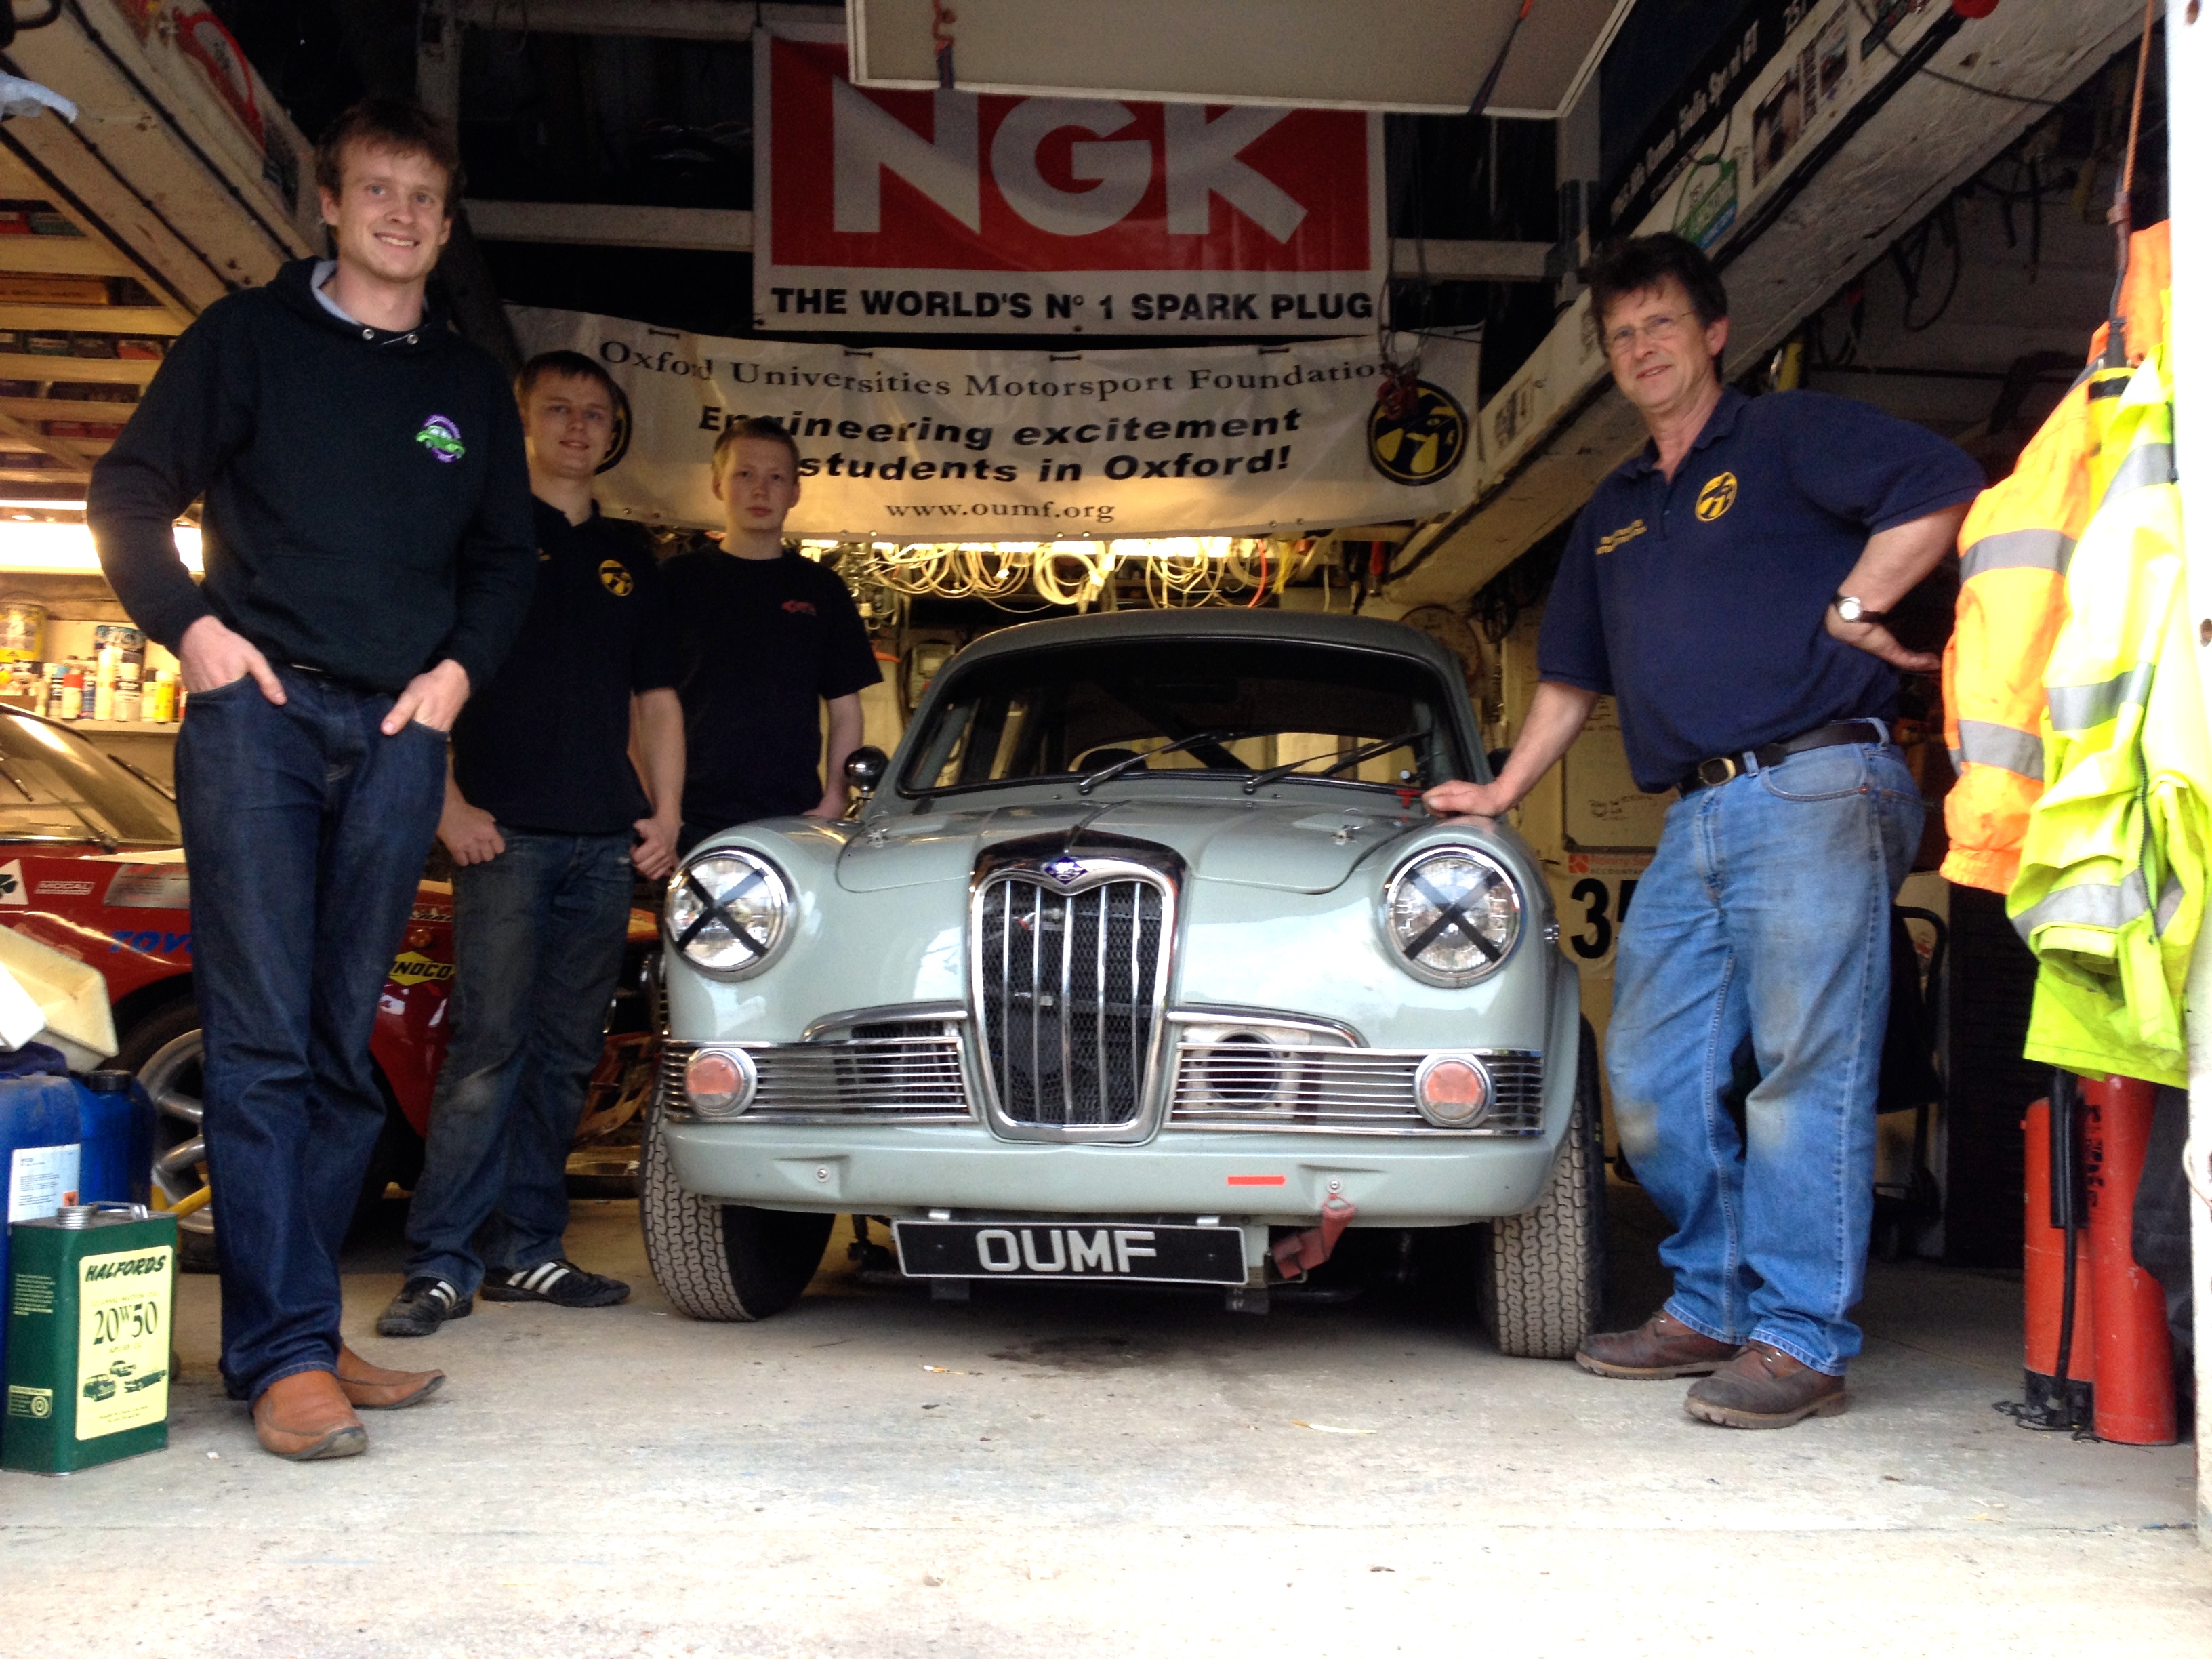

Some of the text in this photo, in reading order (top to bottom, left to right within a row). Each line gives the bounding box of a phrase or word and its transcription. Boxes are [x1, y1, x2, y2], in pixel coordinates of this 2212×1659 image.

[832, 75, 1308, 245] NGK
[771, 287, 847, 314] THE
[861, 289, 1032, 319] WORLD'S
[1099, 295, 1113, 320] 1
[1131, 293, 1266, 321] SPARK
[1271, 292, 1373, 320] PLUG
[600, 340, 714, 380] Oxfod
[729, 361, 951, 396] Universities
[965, 374, 1174, 402] Motorsport
[699, 405, 1301, 451] Enineering excitement
[799, 445, 1292, 482] students in Oxford!
[886, 501, 1115, 523] www.oumf.org
[39, 882, 93, 890] MOCAL
[109, 930, 192, 953] TOY
[392, 961, 453, 978] NOCO
[975, 1229, 1157, 1273] OUMF
[85, 1255, 167, 1282] HALFORDS
